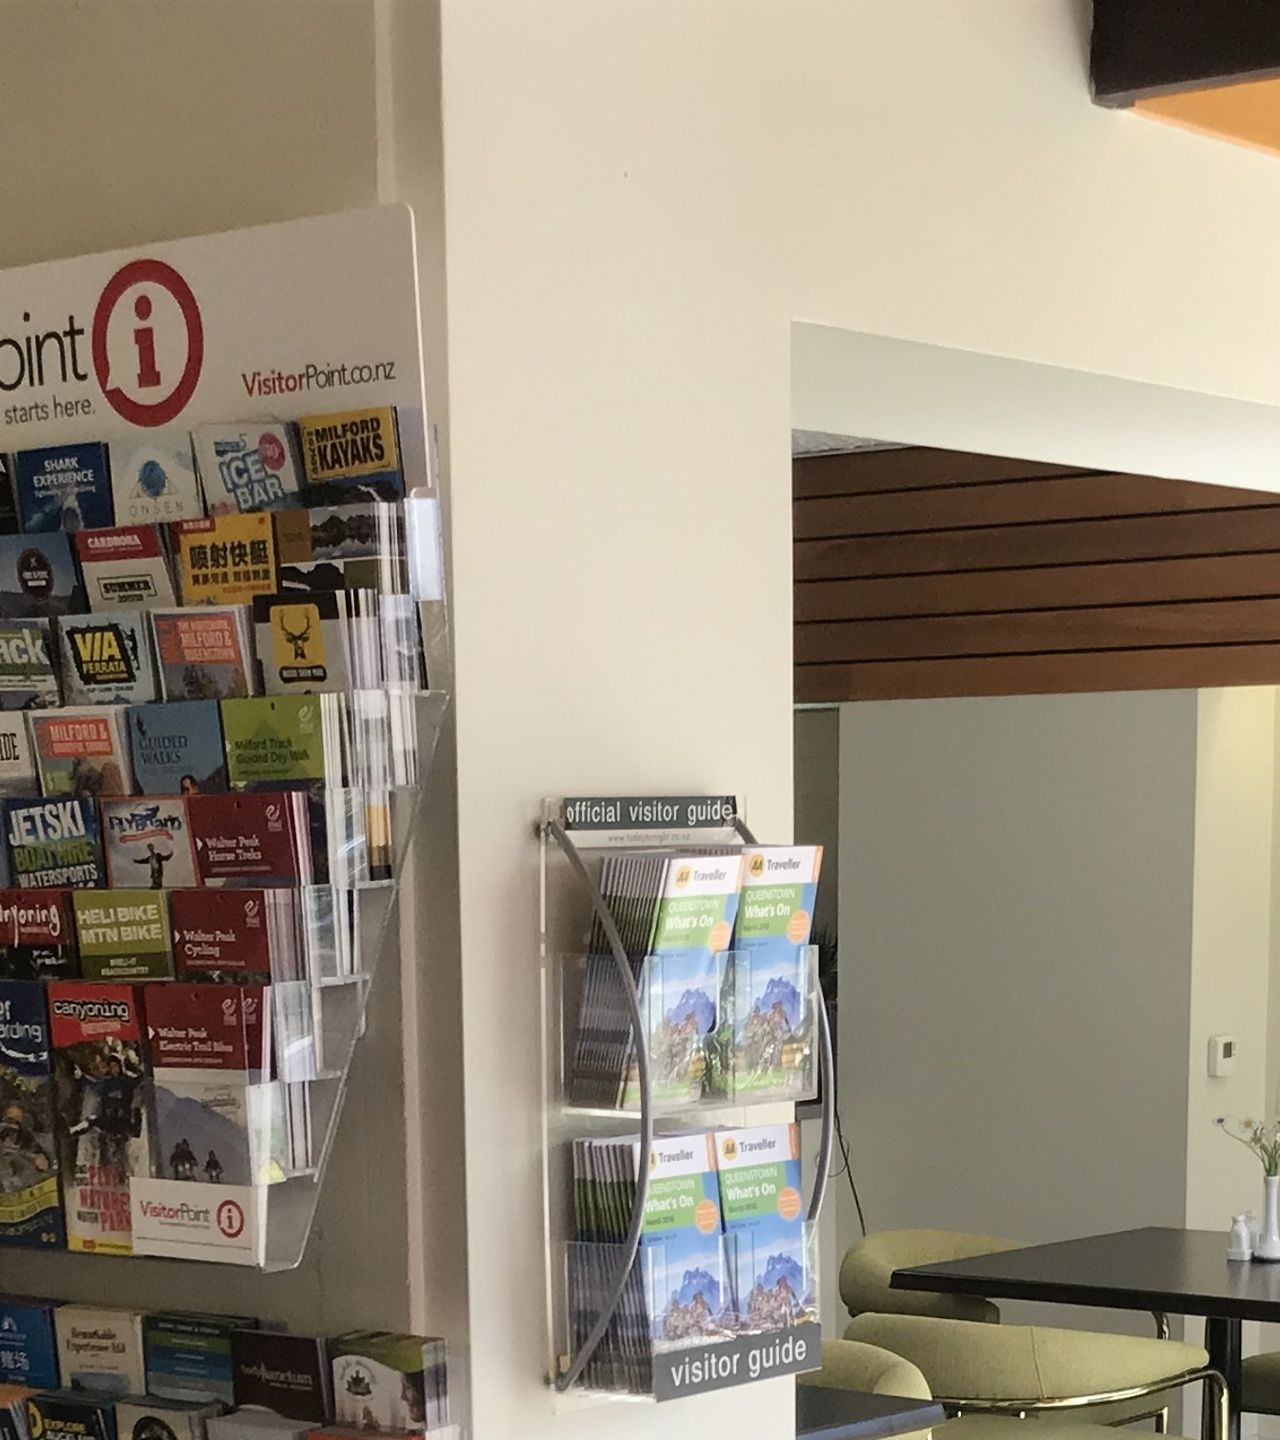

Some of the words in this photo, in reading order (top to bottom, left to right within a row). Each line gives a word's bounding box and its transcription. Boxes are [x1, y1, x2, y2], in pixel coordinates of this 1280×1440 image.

[241, 361, 396, 398] VisitorPoint.co.nz
[4, 402, 50, 427] starts
[53, 396, 96, 418] here.
[314, 417, 382, 444] MILFORD
[317, 434, 385, 472] KAYAKS
[45, 456, 79, 473] SHARK
[221, 454, 269, 490] ICE
[32, 469, 94, 488] EXPERIENCE
[234, 476, 286, 510] BAR
[128, 502, 185, 518] ONSEN
[86, 533, 142, 549] CARDRONA
[102, 579, 153, 594] SUMMER
[74, 632, 123, 660] VIA
[83, 660, 127, 674] FERRATA
[50, 720, 97, 742] MILFORD
[138, 735, 188, 752] GUIDED
[235, 740, 268, 752] Milford
[269, 736, 293, 749] Track
[140, 751, 182, 766] WALKS
[236, 751, 270, 765] Guided
[291, 748, 310, 762] Walk
[567, 800, 621, 824] official
[629, 801, 679, 823] visitor
[687, 799, 734, 825] guide
[9, 801, 86, 846] JETSKI
[205, 836, 237, 848] Walter
[239, 834, 261, 847] Peak
[208, 850, 236, 861] Horse
[237, 849, 262, 860] Treks
[767, 857, 801, 872] Traveller
[19, 863, 98, 888] WATERSPORTS
[693, 868, 728, 882] Traveller
[745, 888, 796, 903] QUEENSTOWN
[78, 907, 115, 925] HELI
[117, 904, 160, 923] BIKE
[668, 899, 720, 914] QUEENSTOWN
[744, 905, 776, 919] What's
[777, 903, 791, 917] On
[665, 916, 698, 931] What's
[699, 914, 715, 928] On
[81, 926, 119, 945] MTN
[122, 922, 163, 941] BIKE
[183, 930, 214, 942] Walter
[216, 929, 236, 942] Peak
[184, 944, 220, 957] Cycling
[52, 1000, 130, 1022] canyoning
[157, 1027, 187, 1039] Walter
[189, 1026, 208, 1038] Peak
[739, 1138, 777, 1153] Traveller
[659, 1150, 694, 1164] Traveller
[725, 1166, 778, 1185] QUEENSTOWN
[726, 1185, 760, 1201] What's
[761, 1182, 776, 1197] On
[139, 1199, 211, 1221] VisitorPoint
[645, 1196, 677, 1212] What's
[678, 1195, 694, 1208] On
[671, 1353, 742, 1388] visitor
[748, 1335, 807, 1378] guide
[44, 1418, 86, 1435] EXPLORE
